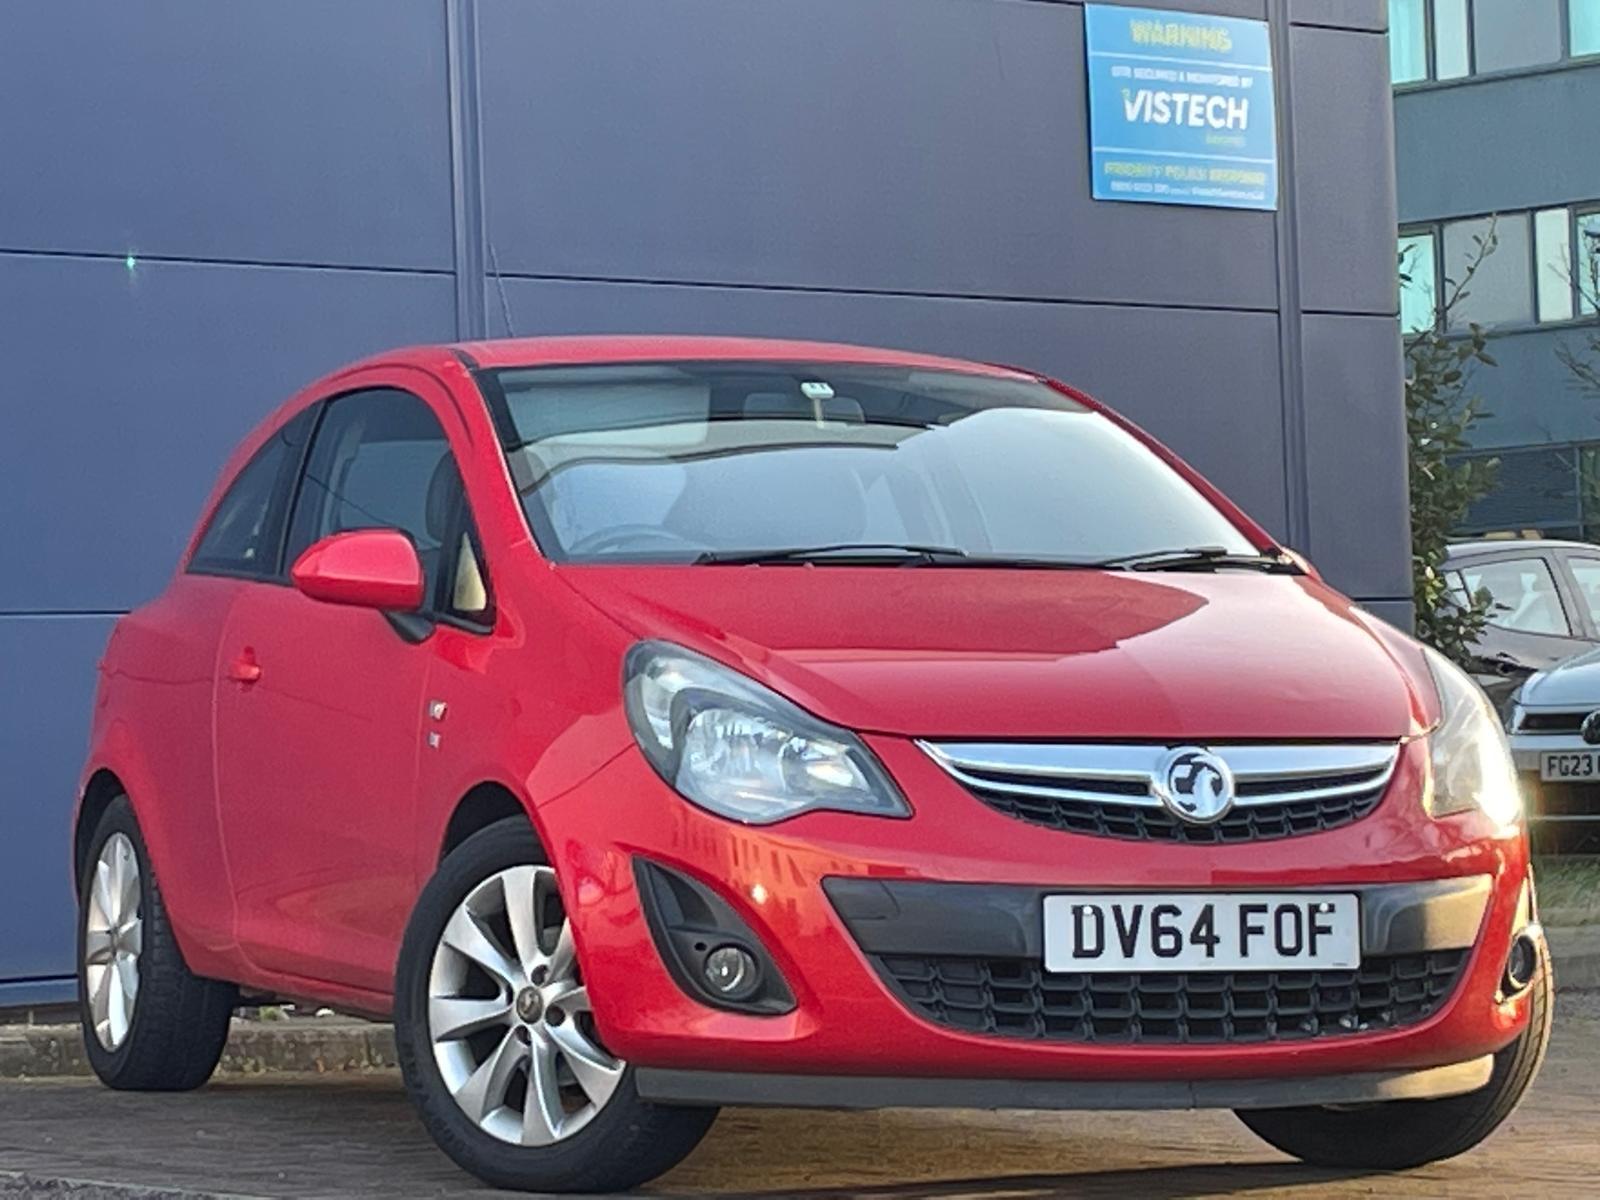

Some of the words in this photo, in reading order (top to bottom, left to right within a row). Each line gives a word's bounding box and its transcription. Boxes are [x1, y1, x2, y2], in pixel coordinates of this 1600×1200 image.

[1122, 88, 1249, 130] VISTECH
[1548, 755, 1593, 777] FG23
[1071, 904, 1220, 959] DV64
[1239, 903, 1335, 957] FOF
